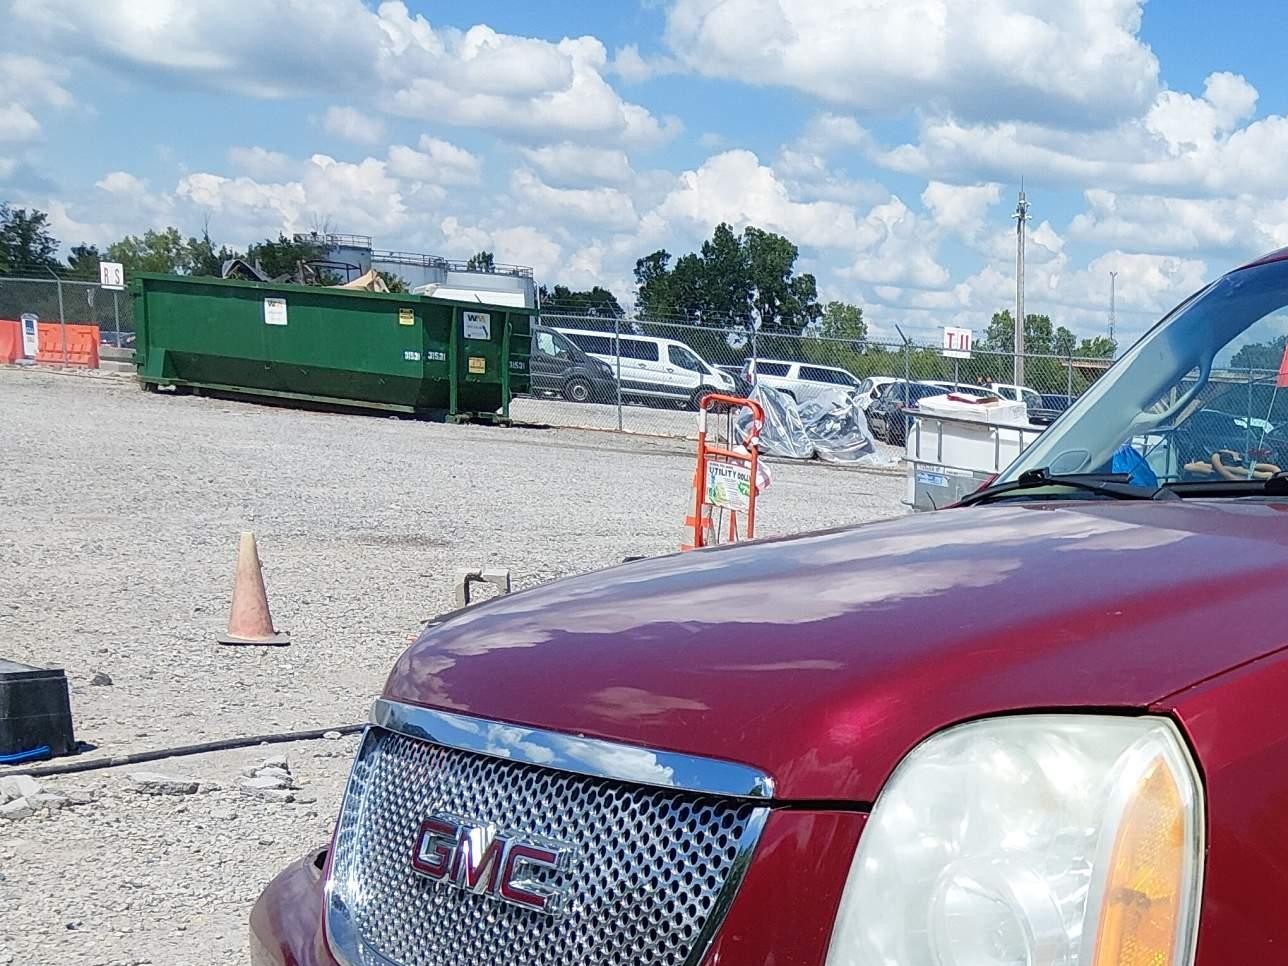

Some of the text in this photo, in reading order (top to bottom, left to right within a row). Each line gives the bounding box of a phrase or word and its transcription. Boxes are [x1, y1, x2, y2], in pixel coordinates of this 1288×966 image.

[947, 332, 955, 349] T
[709, 466, 737, 478] UTILITY
[411, 817, 568, 914] GMC
